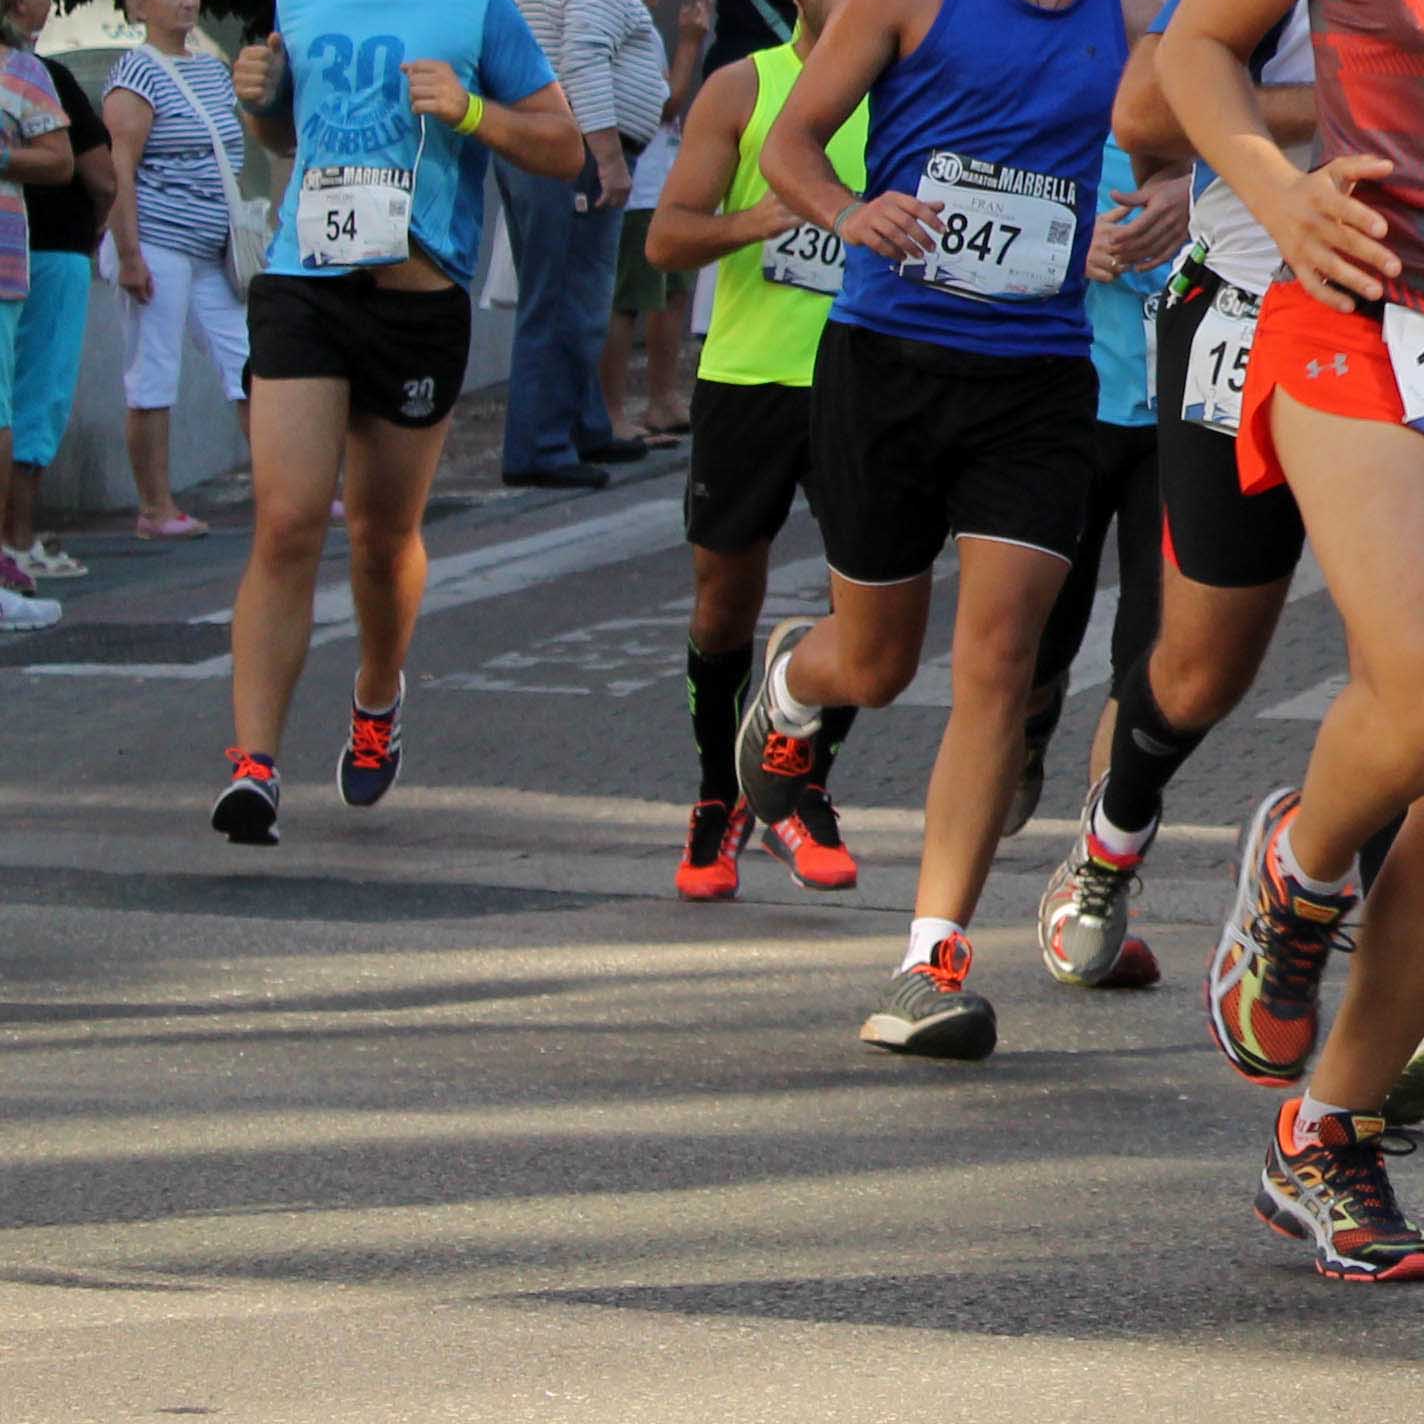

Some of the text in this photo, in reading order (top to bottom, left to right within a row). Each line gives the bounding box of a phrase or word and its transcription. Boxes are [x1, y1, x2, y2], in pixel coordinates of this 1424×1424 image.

[307, 32, 406, 106] 30
[343, 166, 411, 189] MARBELLA
[998, 167, 1076, 206] MARBELLA
[325, 208, 357, 242] 54
[941, 213, 1022, 266] 847
[777, 226, 846, 269] 230
